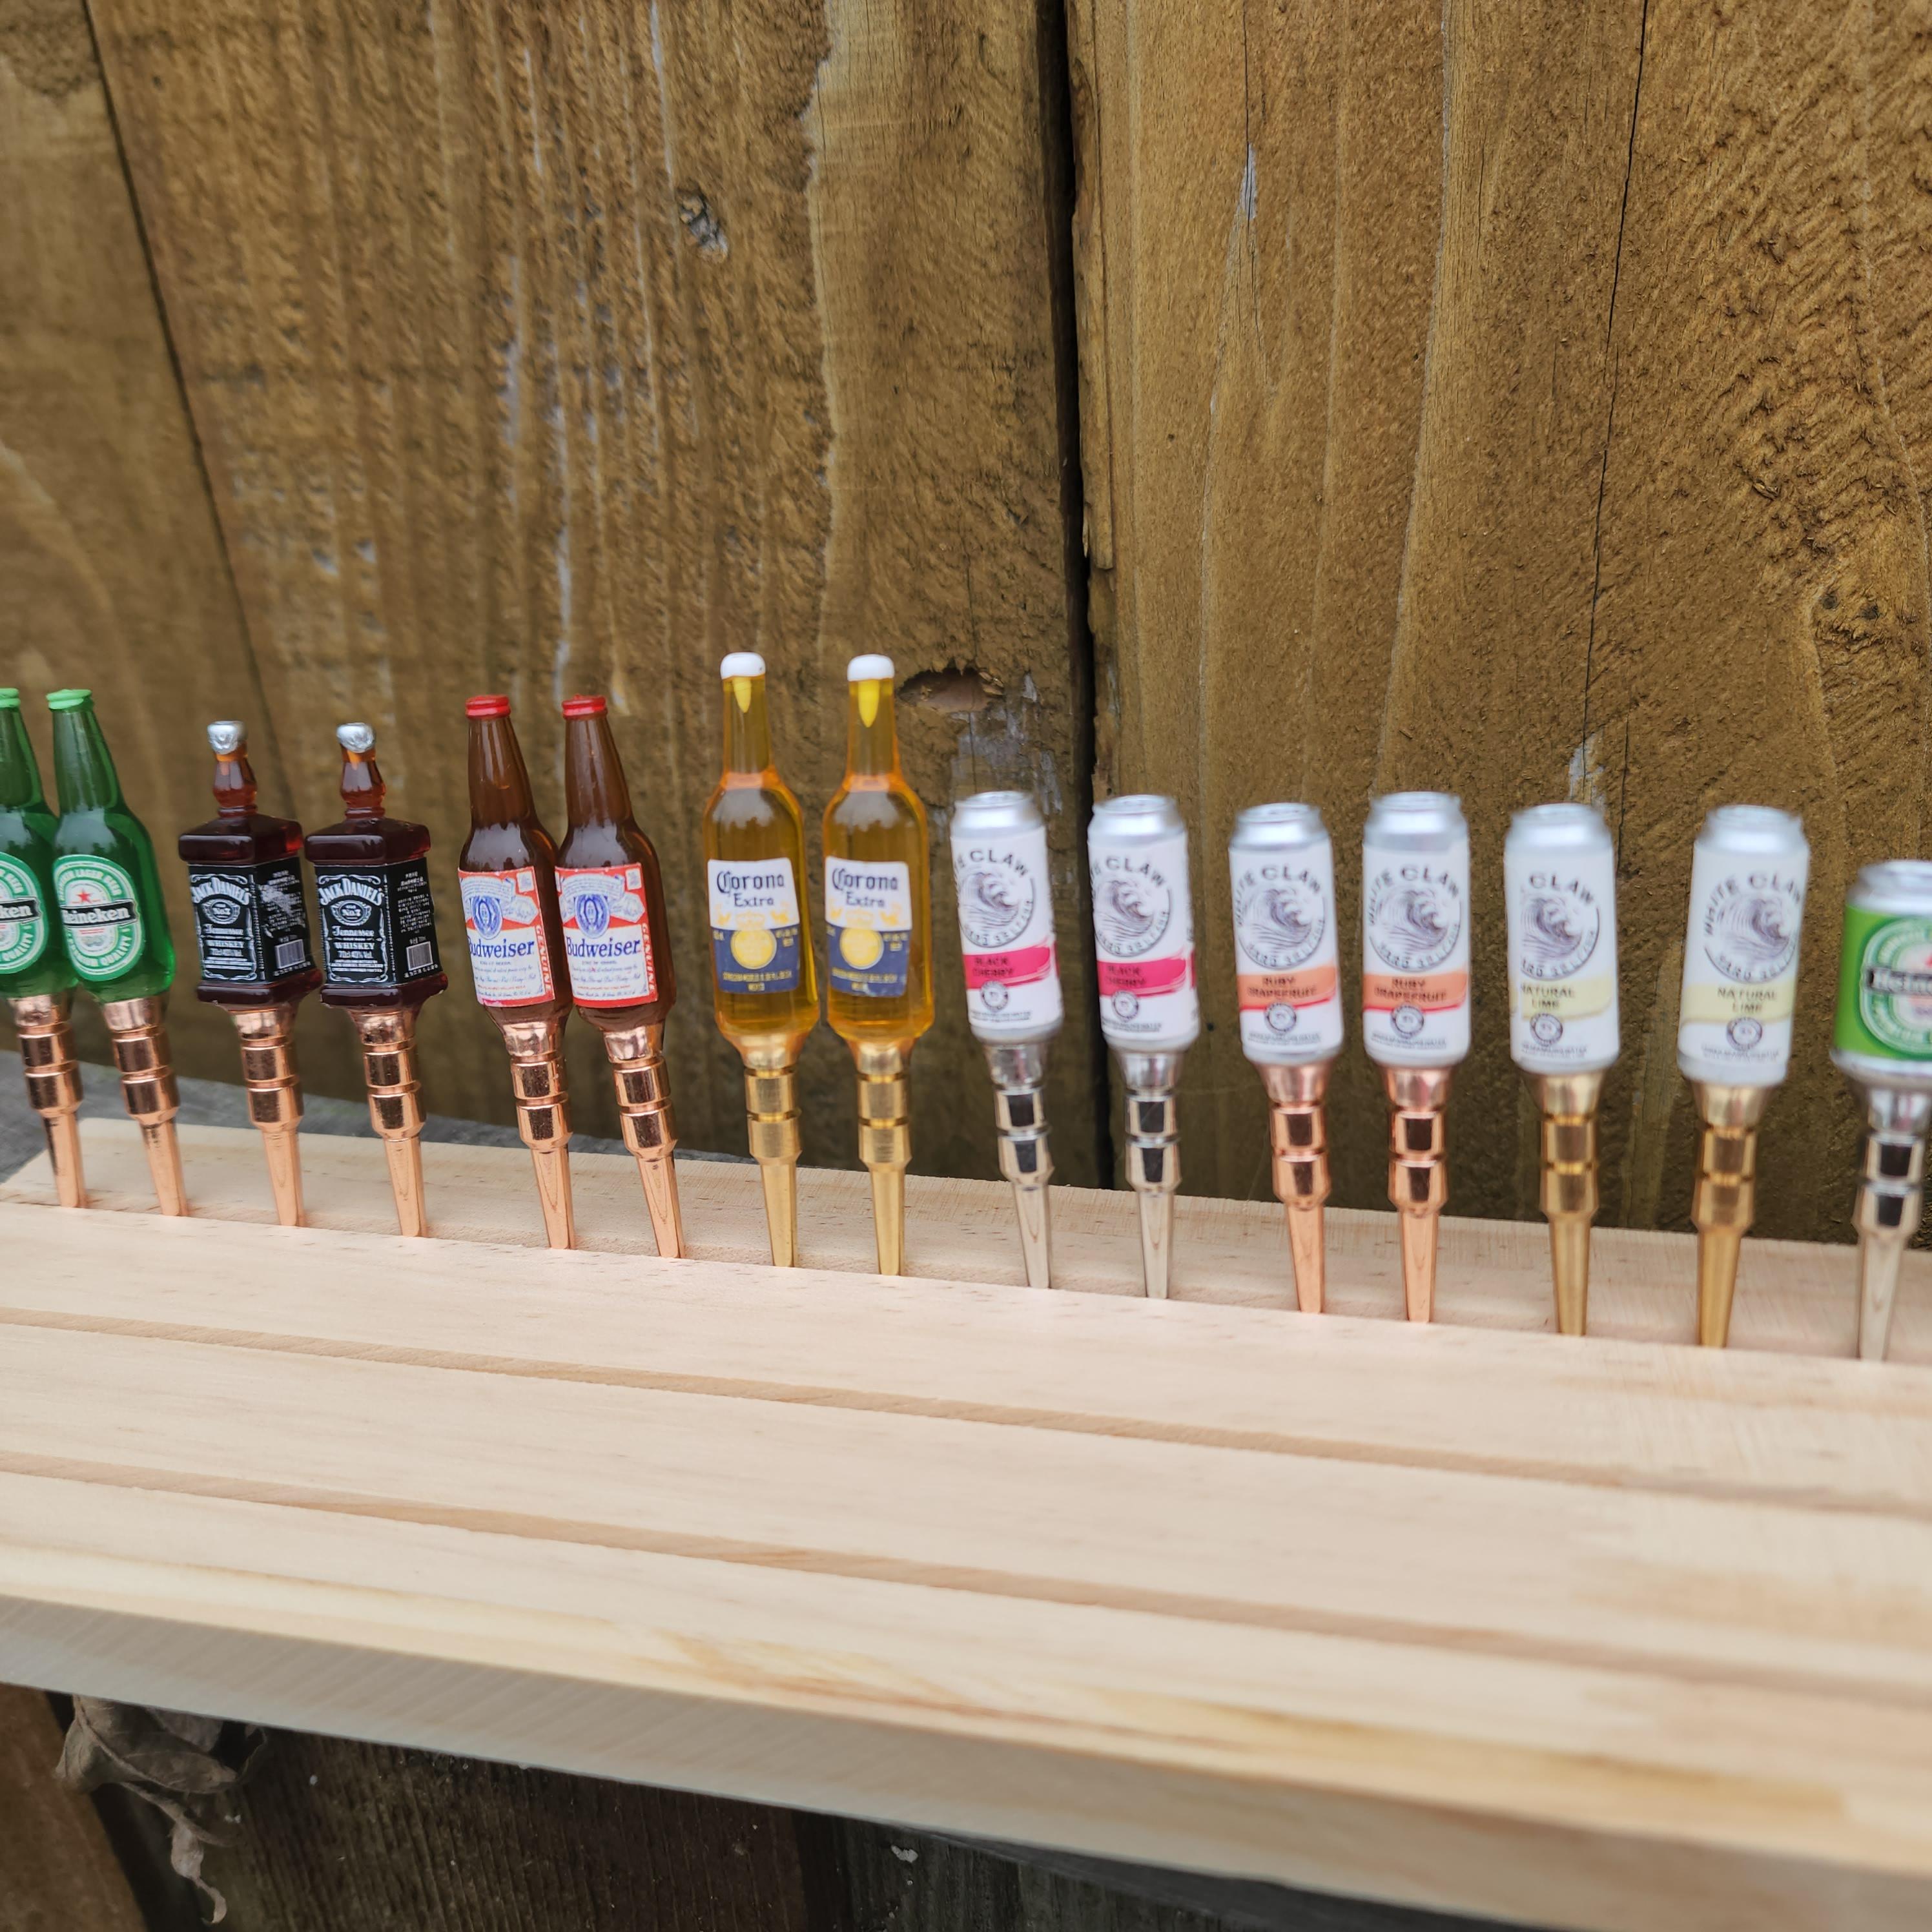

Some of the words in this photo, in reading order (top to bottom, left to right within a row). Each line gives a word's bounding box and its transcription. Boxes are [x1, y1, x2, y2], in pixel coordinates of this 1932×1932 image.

[970, 849, 1029, 876] CLAW
[1105, 857, 1166, 887] CLAW
[716, 870, 785, 894] Corona
[832, 867, 899, 891] Corona
[1262, 865, 1321, 894] CLAW
[1401, 866, 1459, 898] CLAW
[1529, 873, 1595, 905] CLAW
[318, 882, 344, 905] JACK
[734, 892, 774, 907] Extra
[846, 891, 885, 907] Extra
[566, 936, 641, 958] Budweiser
[1717, 987, 1778, 1000] NATURAL
